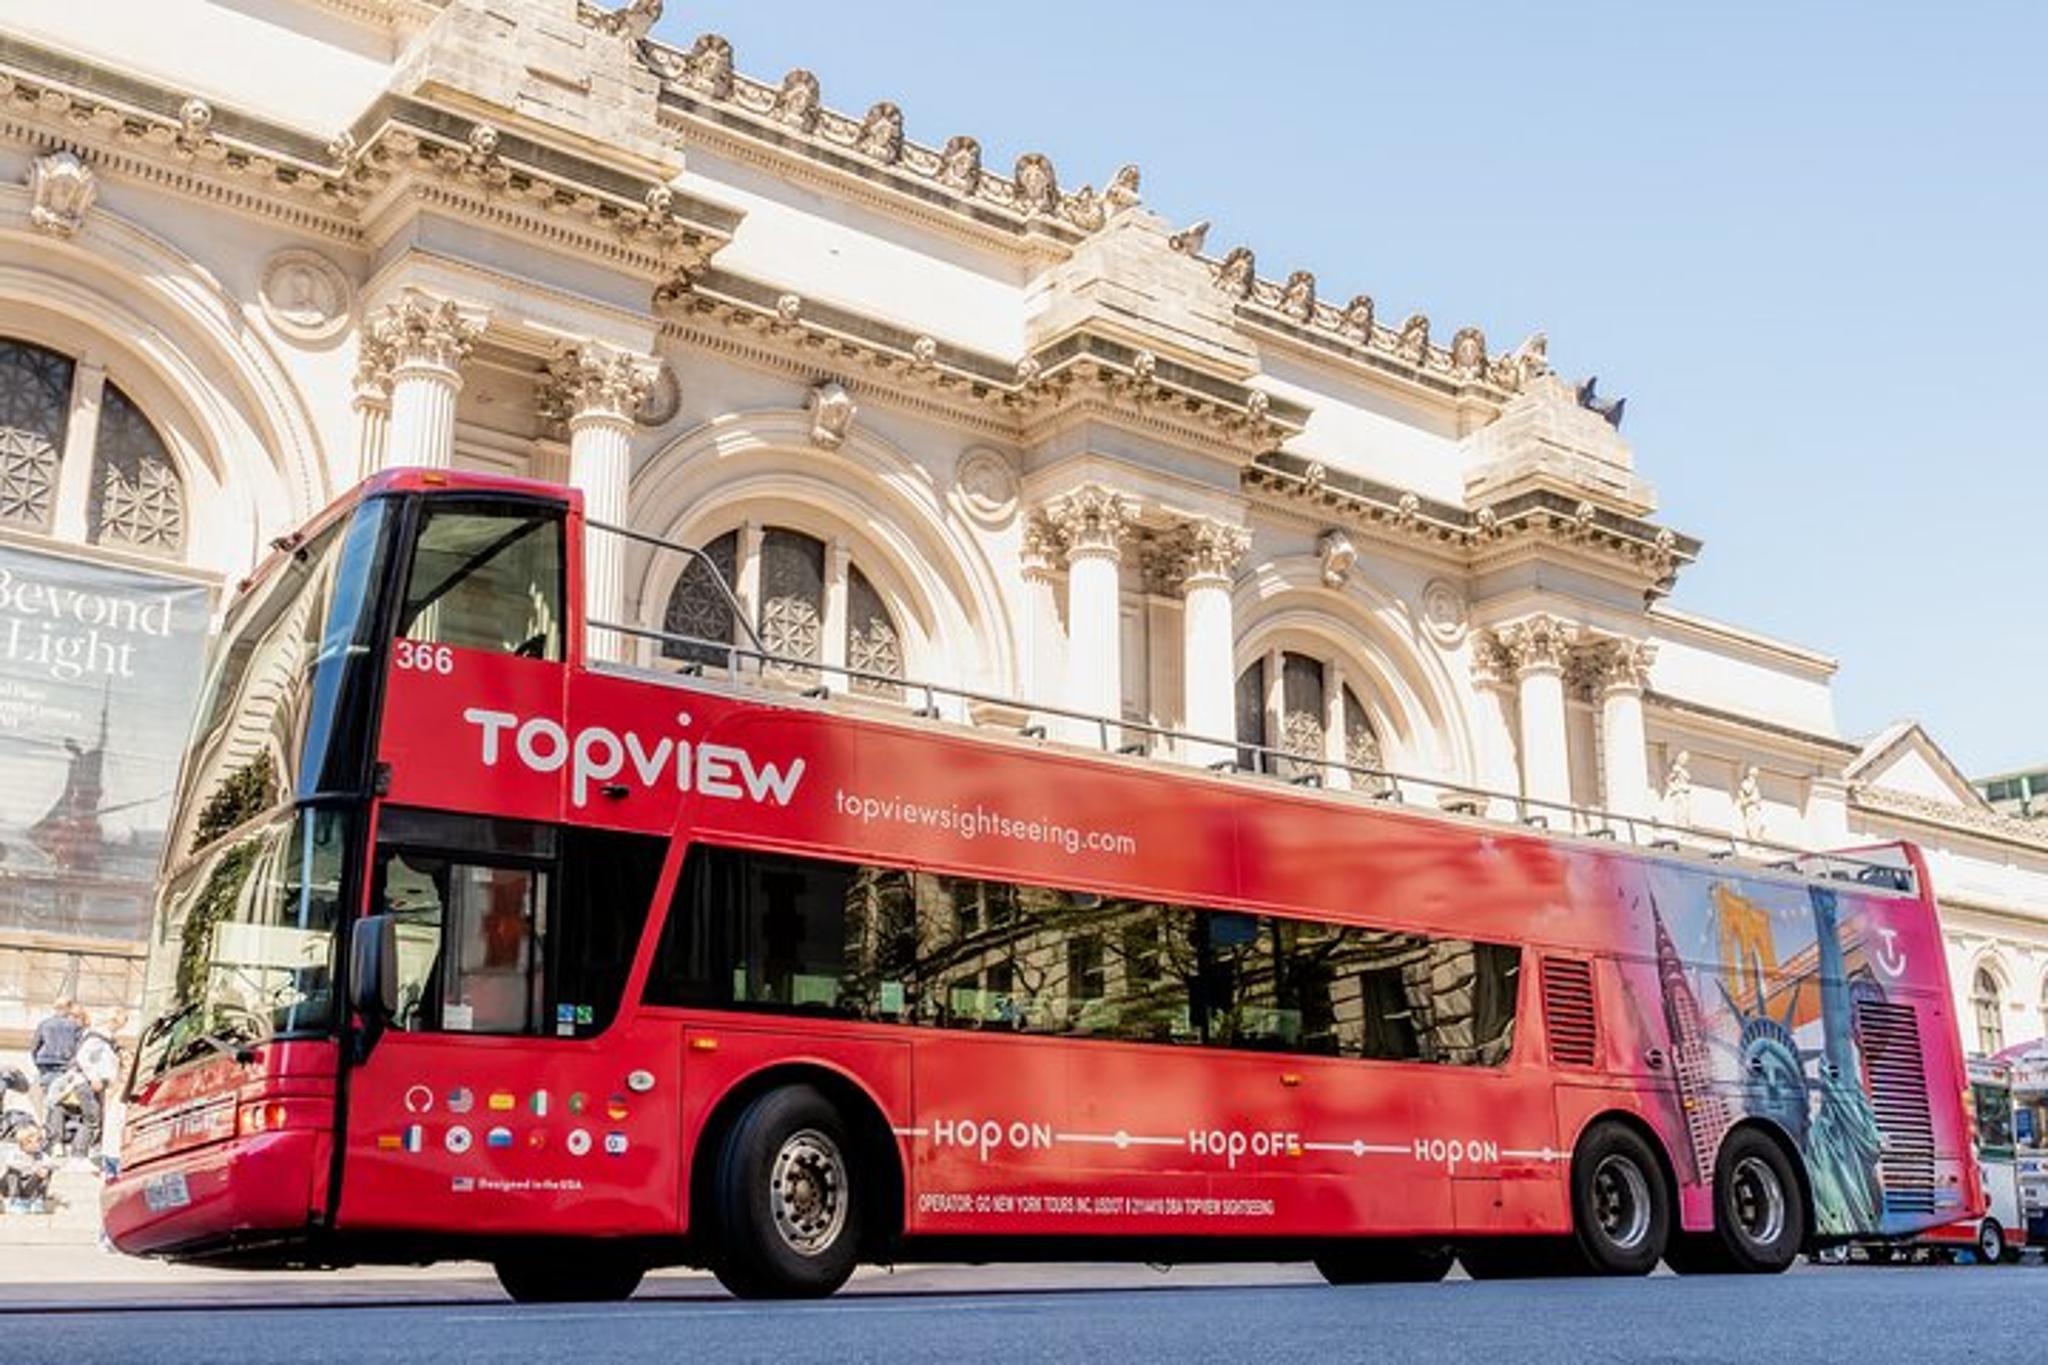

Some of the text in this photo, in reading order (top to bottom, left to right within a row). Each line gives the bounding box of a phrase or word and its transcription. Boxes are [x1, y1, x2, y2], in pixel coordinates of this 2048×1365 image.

[6, 617, 137, 681] Light
[396, 642, 454, 675] 366
[835, 788, 1137, 855] topviewsightseeing.com
[1008, 1121, 1051, 1150] ON
[1251, 1131, 1299, 1157] OFF
[1466, 1140, 1499, 1163] ON
[477, 1177, 530, 1193] Designed
[1017, 1195, 1042, 1214] YORK
